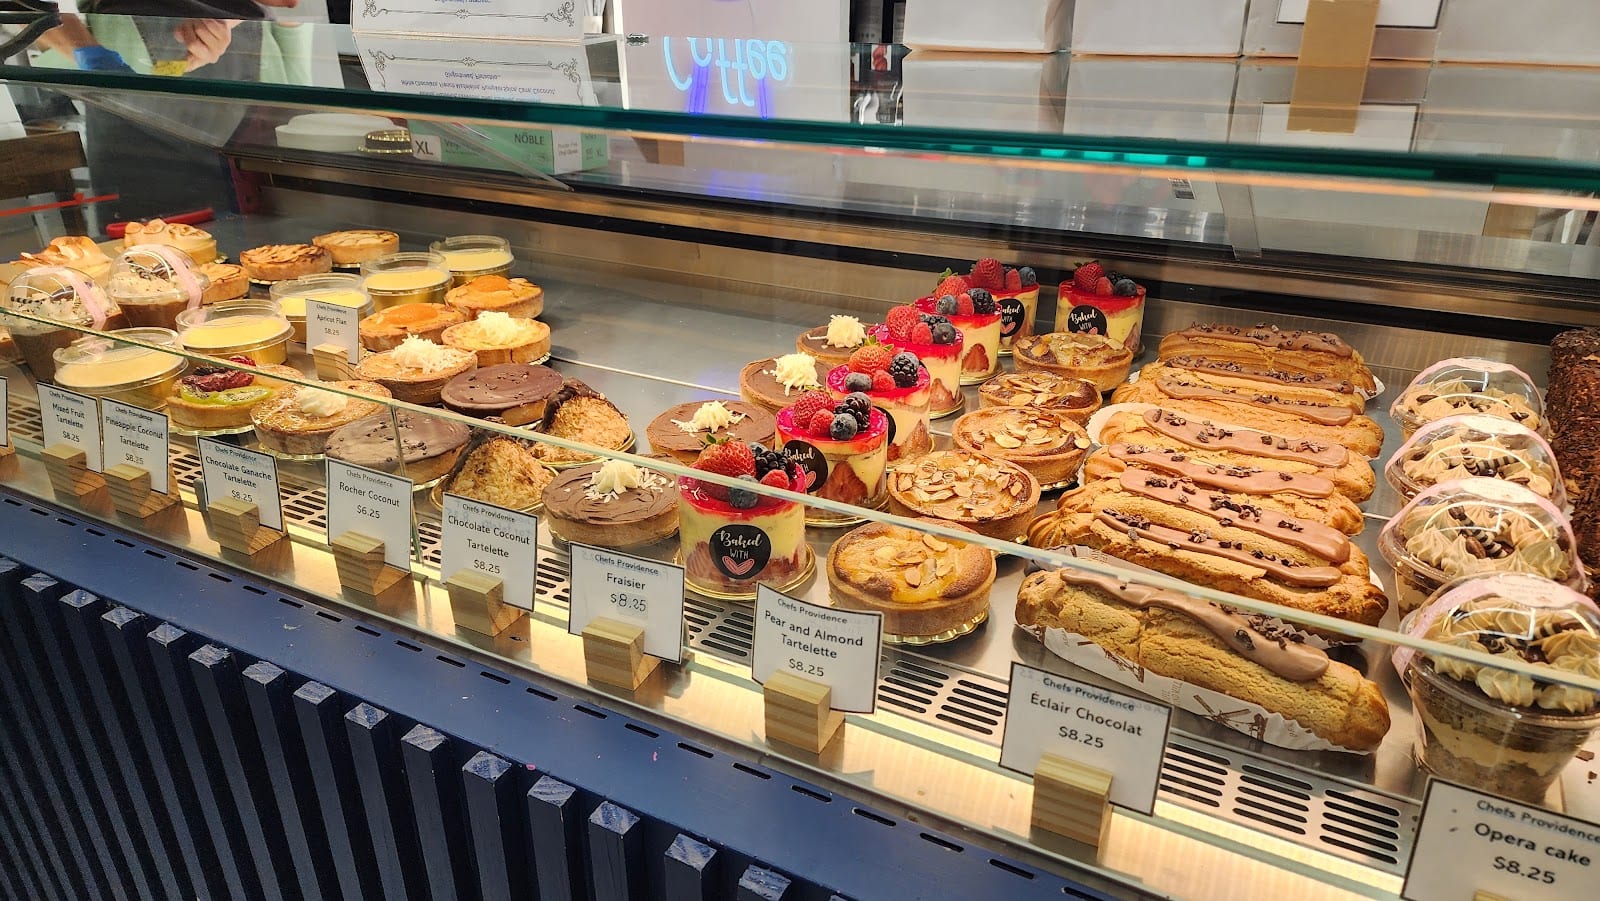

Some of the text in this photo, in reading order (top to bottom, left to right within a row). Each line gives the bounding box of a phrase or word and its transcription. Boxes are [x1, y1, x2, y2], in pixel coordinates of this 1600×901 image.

[416, 140, 434, 156] XL
[1001, 304, 1020, 314] aked
[1069, 308, 1097, 324] Baked
[317, 314, 334, 323] Apricot
[1079, 321, 1092, 331] WITH
[324, 328, 340, 336] $8.25
[50, 391, 60, 399] Chefs
[52, 402, 85, 418] Mixed Fruit
[115, 406, 152, 422] Chefs Providence
[56, 414, 84, 429] Tartelette
[106, 416, 164, 440] Pineapple Coconut
[62, 431, 80, 442] $8.25
[120, 436, 149, 451] Tartelette
[125, 452, 144, 465] $8.25
[214, 446, 256, 462] Chefs Providence
[784, 446, 815, 462] Baked
[206, 456, 272, 480] Chocolate Ganache
[223, 472, 256, 488] Tartelette
[346, 469, 392, 488] Chefs Providence
[232, 489, 252, 502] $8.25
[340, 482, 400, 508] Rocher Coconut
[357, 504, 380, 518] $6.25
[462, 504, 515, 522] Chefs Providence
[448, 515, 530, 545] Chocolate Coconut
[716, 530, 762, 548] Baked
[467, 538, 510, 558] Tartelette
[730, 548, 749, 560] WITH
[474, 560, 500, 574] $8.25
[594, 554, 660, 575] Chefs Providence
[606, 572, 646, 590] Fraisier
[610, 593, 647, 612] $8.25
[778, 598, 848, 624] Chefs Providence
[764, 610, 863, 646] Pear and Almond
[781, 634, 838, 659] Tartelette
[788, 658, 824, 677] $8.25
[1043, 677, 1136, 712] Chefs Providence
[1030, 690, 1144, 736] Éclair Chocolat
[1058, 726, 1104, 749] $8.25
[1476, 800, 1600, 844] Chefs Providence
[1474, 822, 1592, 866] Opera cake
[1492, 856, 1556, 885] $8.25
